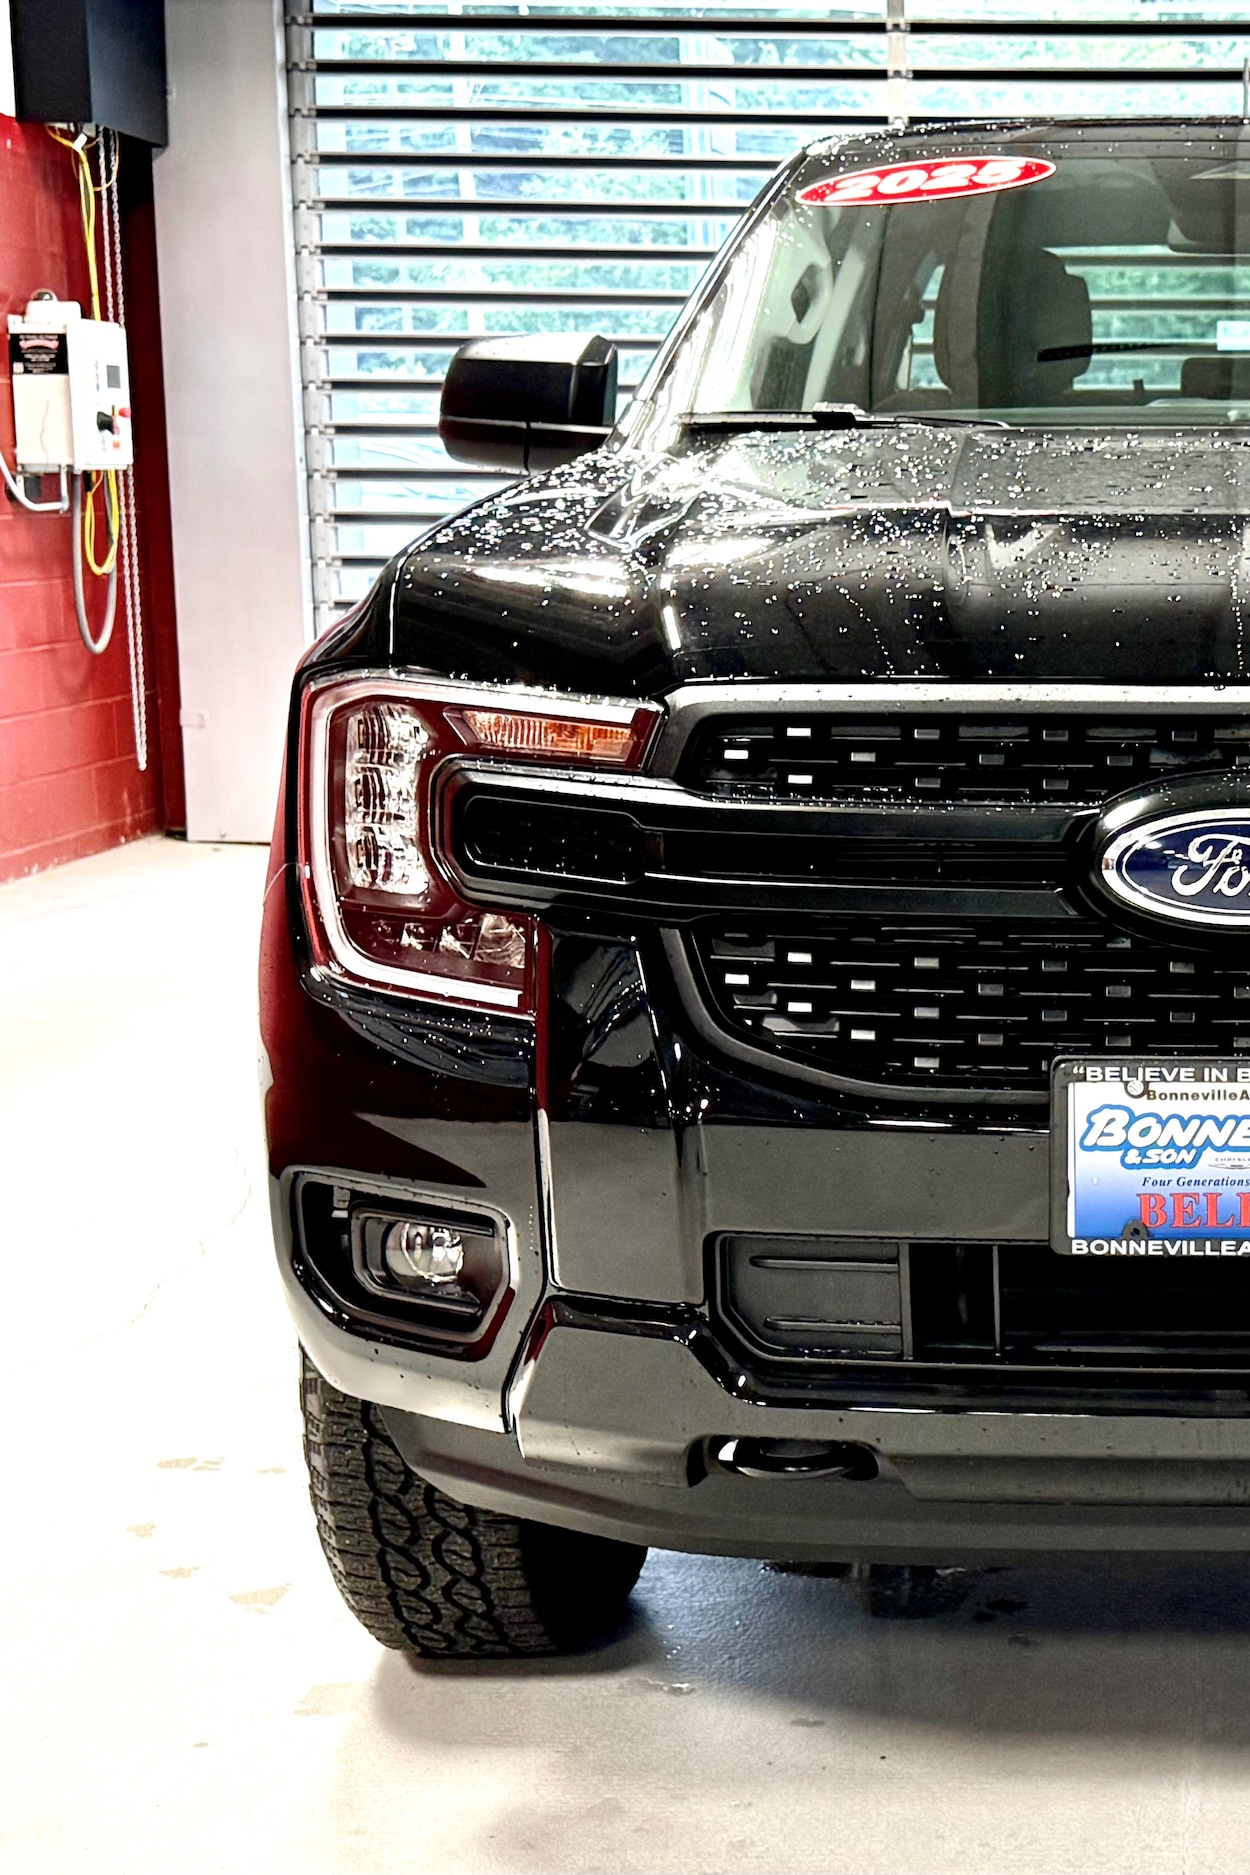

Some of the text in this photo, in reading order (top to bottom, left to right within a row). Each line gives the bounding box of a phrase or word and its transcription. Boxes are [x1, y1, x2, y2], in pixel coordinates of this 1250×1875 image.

[823, 160, 1026, 201] 2025
[1203, 1067, 1228, 1083] IN
[1141, 1176, 1173, 1187] Four
